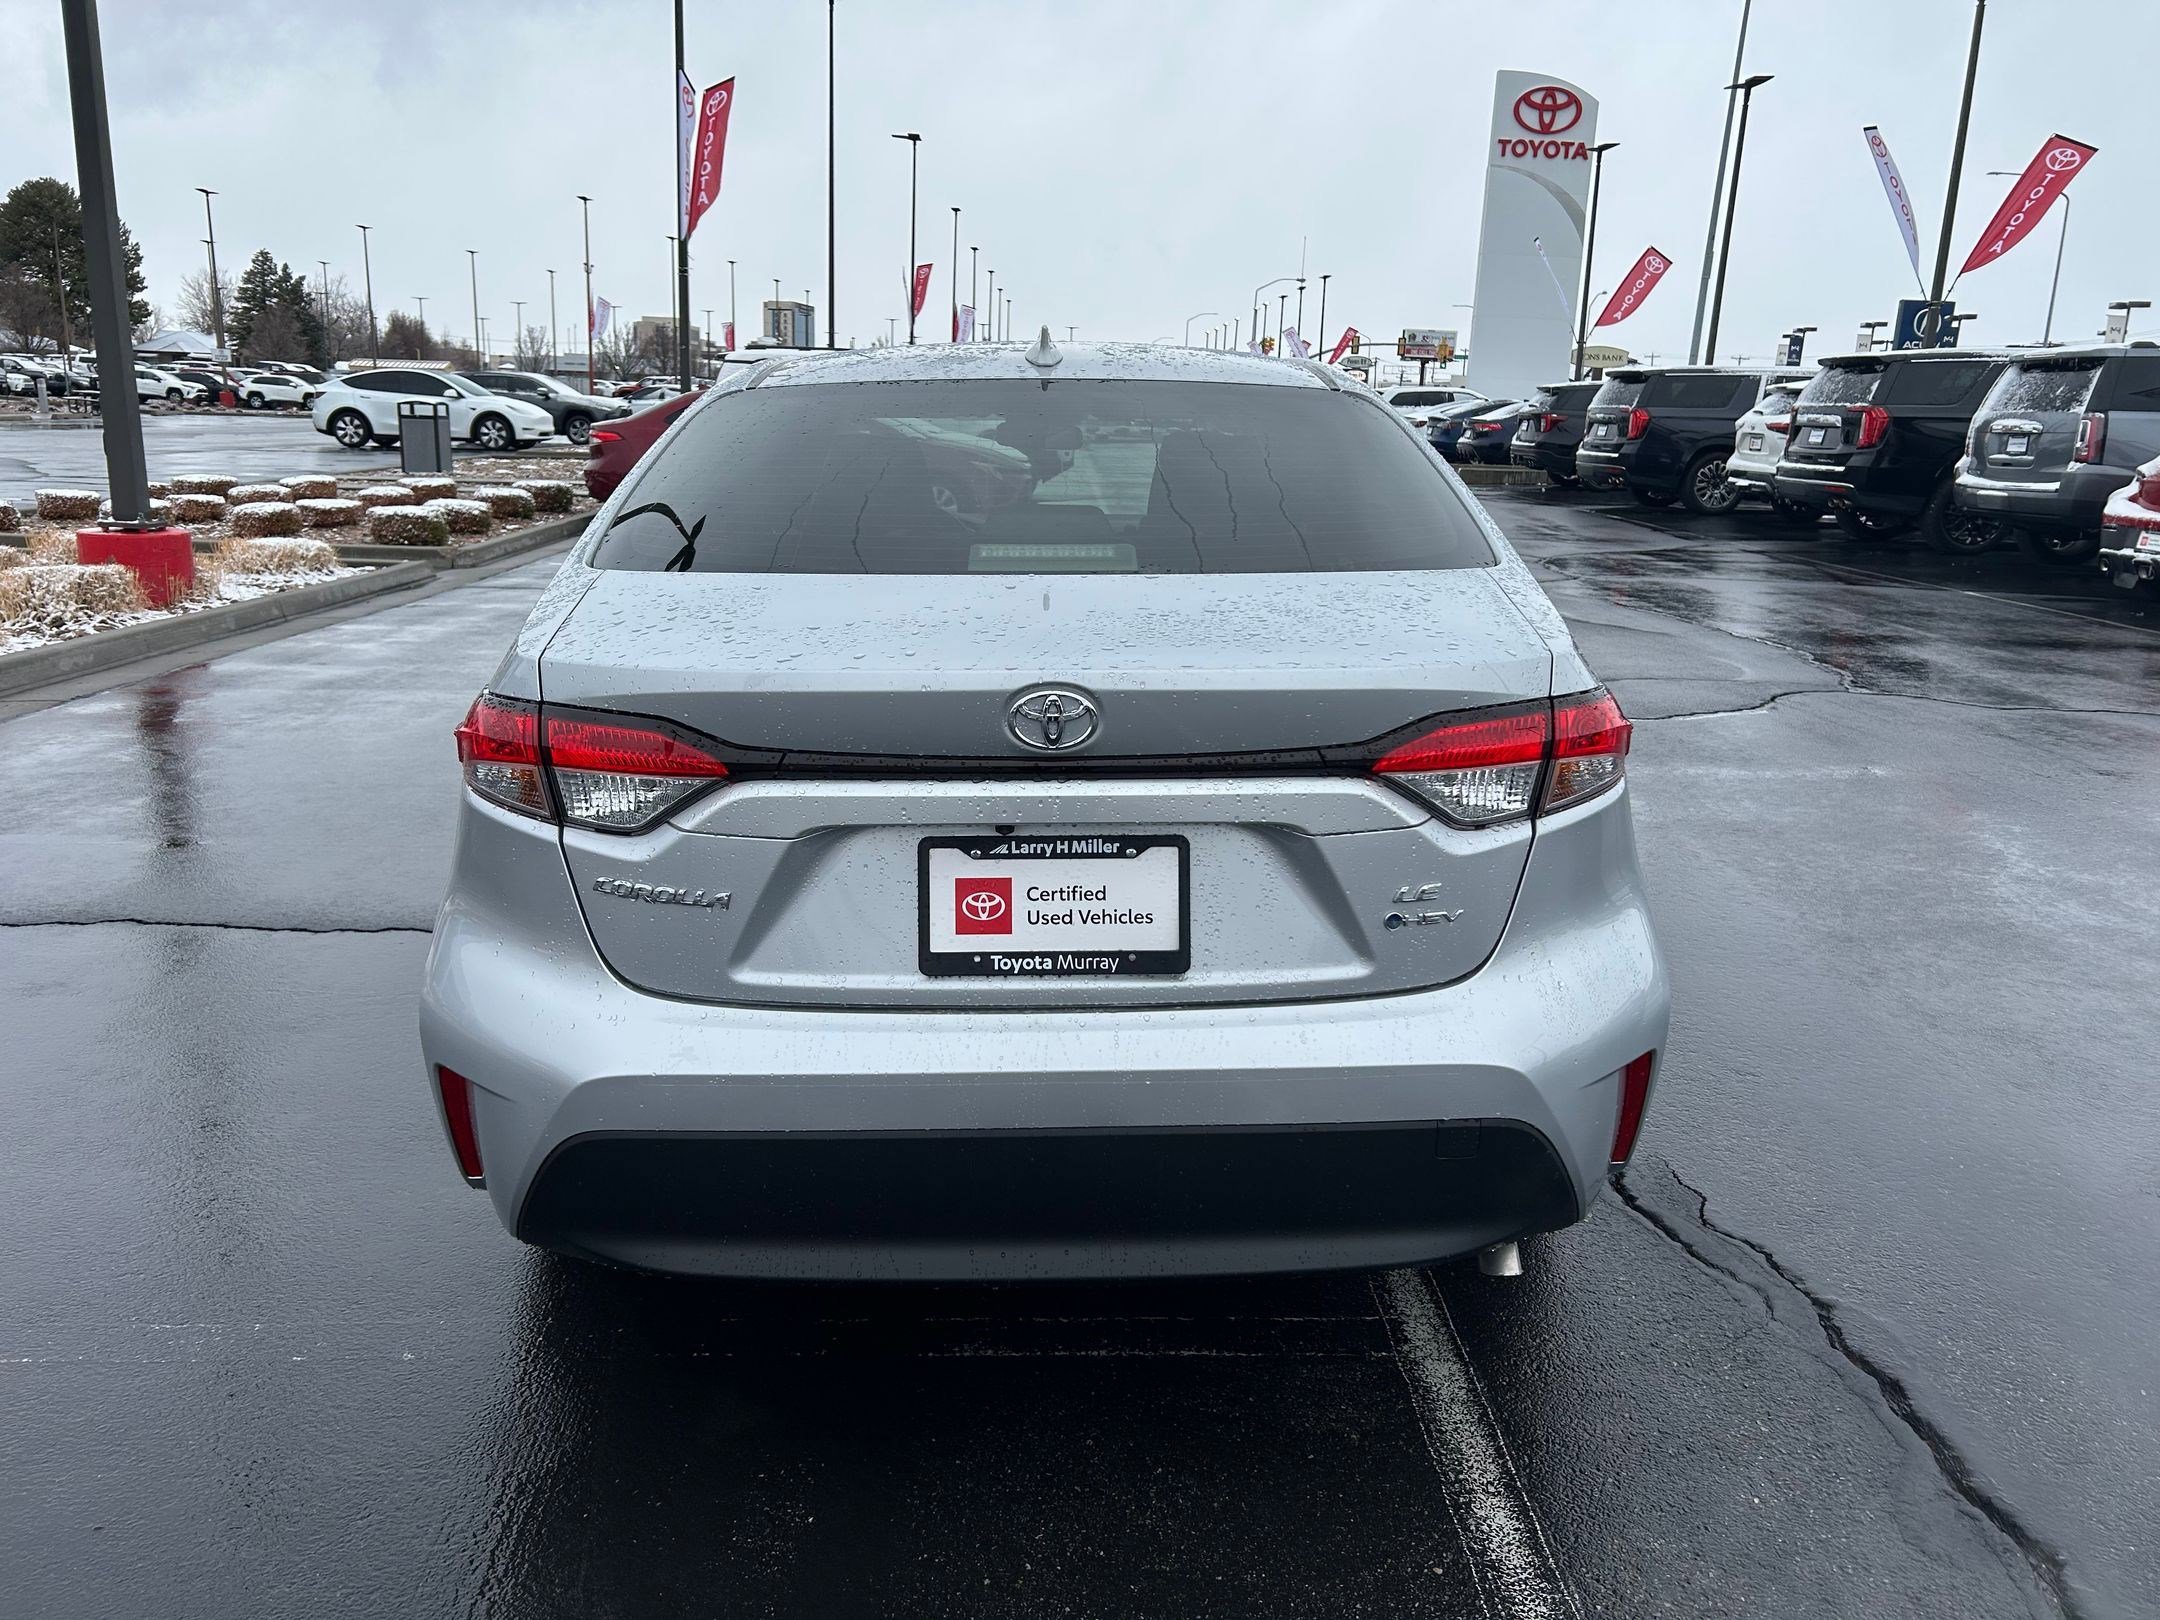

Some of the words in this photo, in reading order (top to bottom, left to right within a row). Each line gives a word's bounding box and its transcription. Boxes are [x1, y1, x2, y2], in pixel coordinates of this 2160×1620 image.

[1498, 138, 1589, 161] TOYOTA
[697, 117, 716, 206] TOYOTA
[1989, 173, 2055, 253] TOYOTA
[1613, 271, 1651, 321] TOYOTA
[1602, 354, 1624, 362] BANK
[1011, 840, 1053, 857] Larry
[1056, 840, 1070, 854] H
[1072, 839, 1120, 854] Miller
[593, 876, 732, 911] COROLLA
[1026, 885, 1107, 902] Certified
[1392, 883, 1442, 903] LE
[1027, 910, 1074, 926] Used
[1078, 909, 1154, 925] Vehicles
[990, 955, 1052, 974] Toyota
[1057, 954, 1120, 972] Murray
